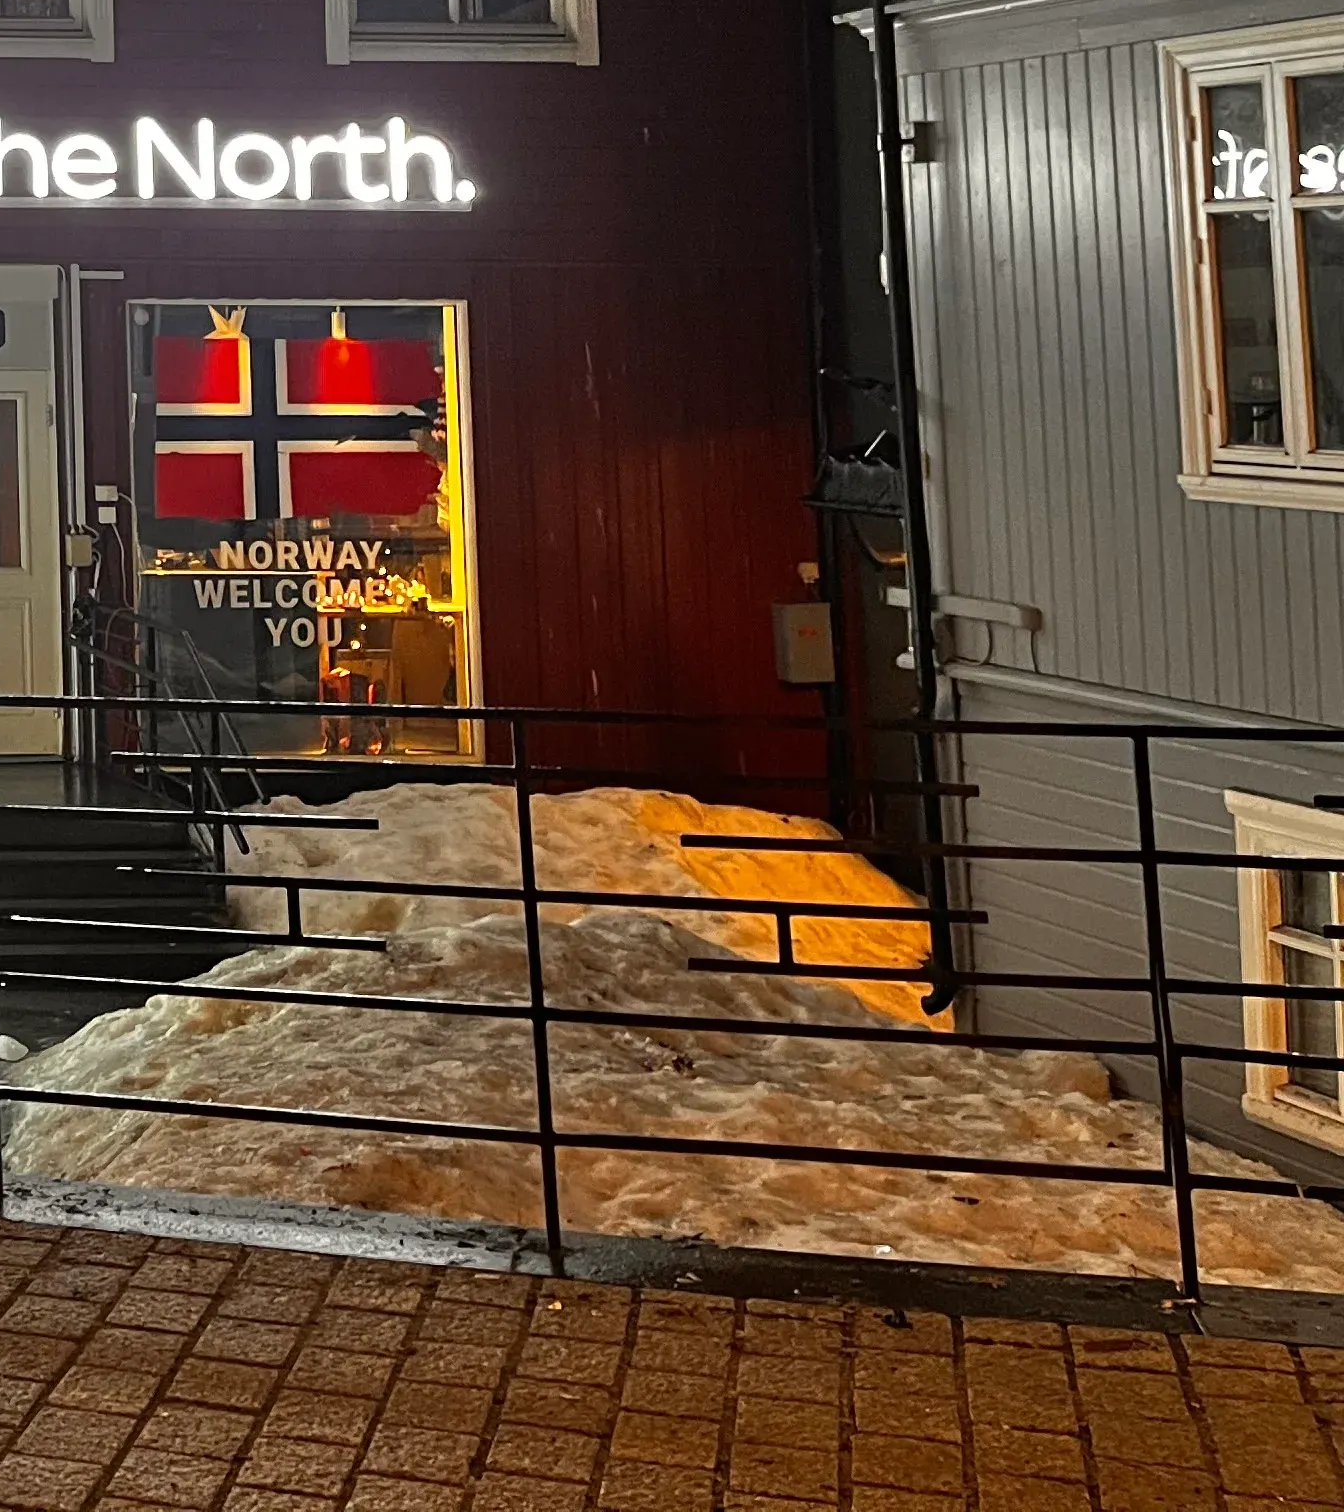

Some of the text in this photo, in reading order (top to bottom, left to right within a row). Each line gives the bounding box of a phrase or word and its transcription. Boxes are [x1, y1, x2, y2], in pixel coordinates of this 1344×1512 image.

[136, 116, 476, 208] North.
[218, 540, 384, 571] NORWAY
[193, 578, 409, 609] WELCOME
[263, 616, 344, 648] YOU
